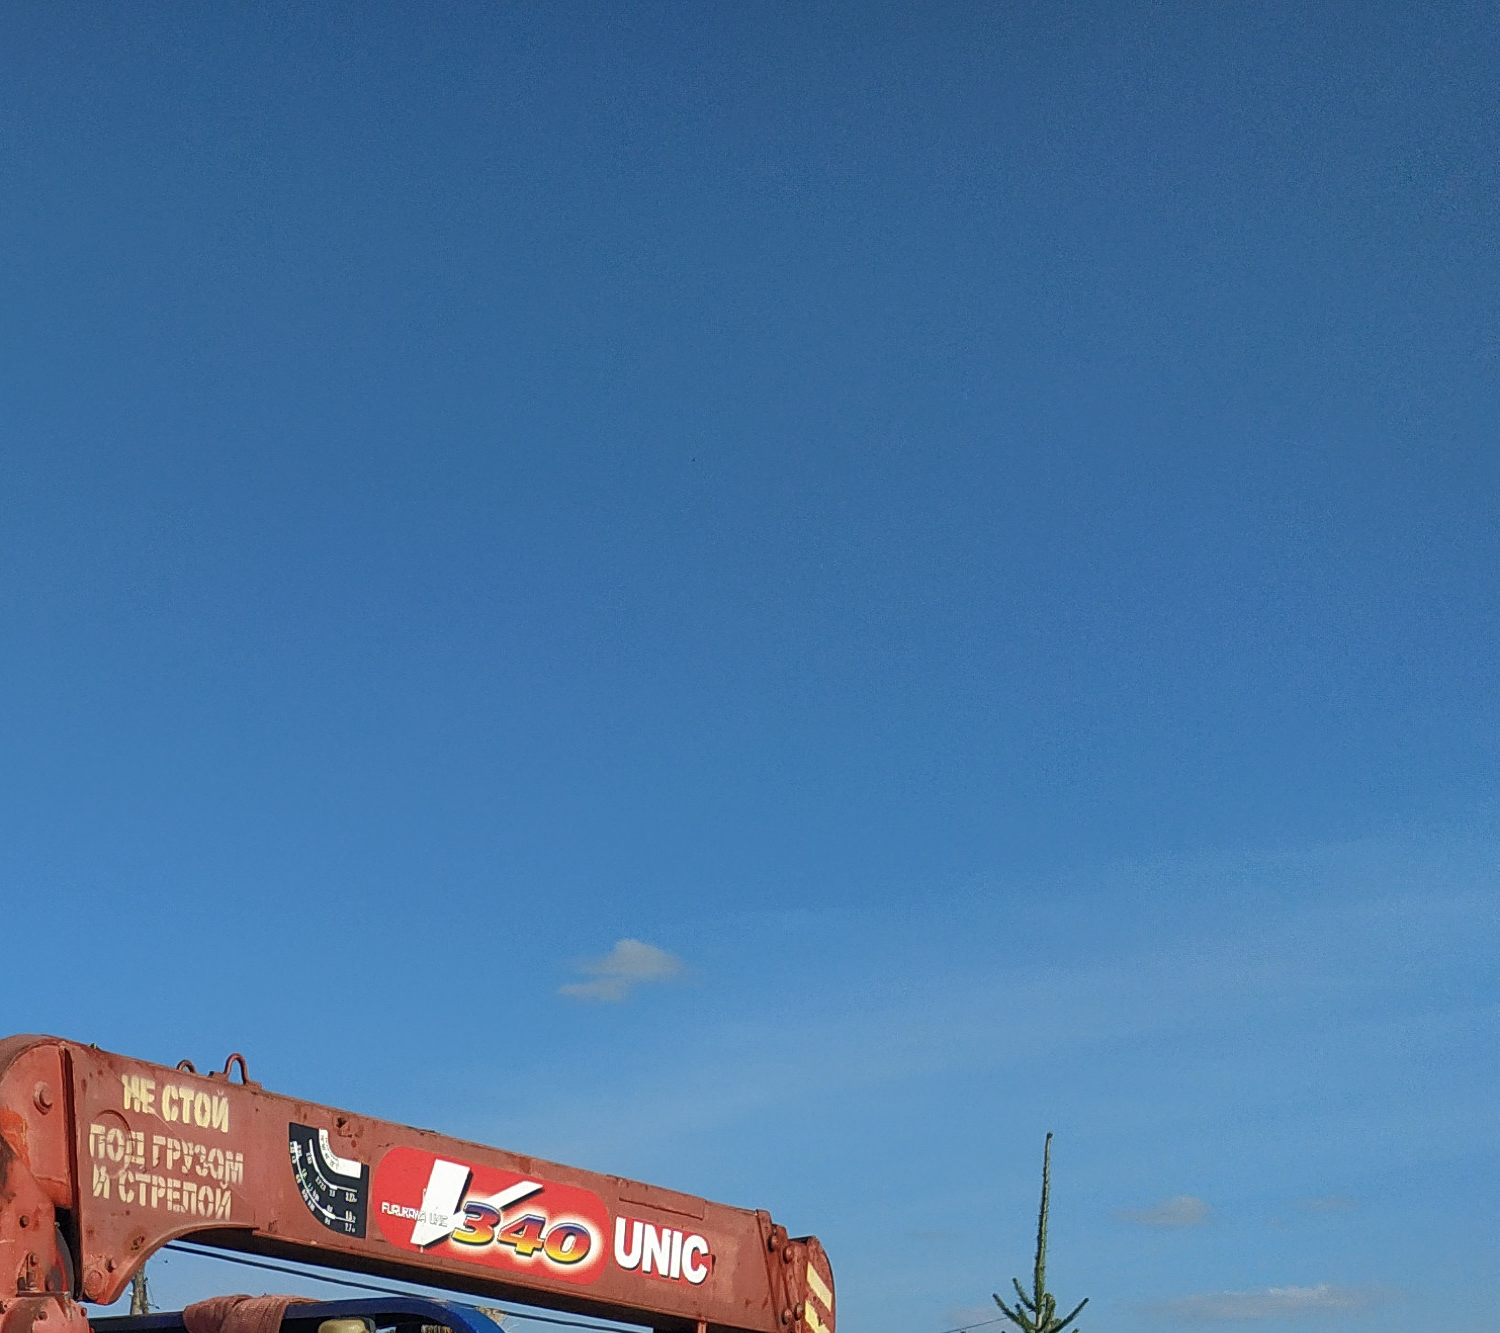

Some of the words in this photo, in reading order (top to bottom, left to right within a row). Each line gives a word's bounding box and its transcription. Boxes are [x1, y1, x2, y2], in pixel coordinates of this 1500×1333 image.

[121, 1074, 156, 1115] НЕ
[162, 1084, 229, 1133] СТОЙ
[89, 1123, 146, 1169] ПОД
[152, 1135, 244, 1185] ГРУЗОМ
[92, 1164, 110, 1199] И
[118, 1171, 232, 1221] СТРЕЛОЙ
[452, 1201, 592, 1265] 340
[614, 1216, 710, 1285] UNIC
